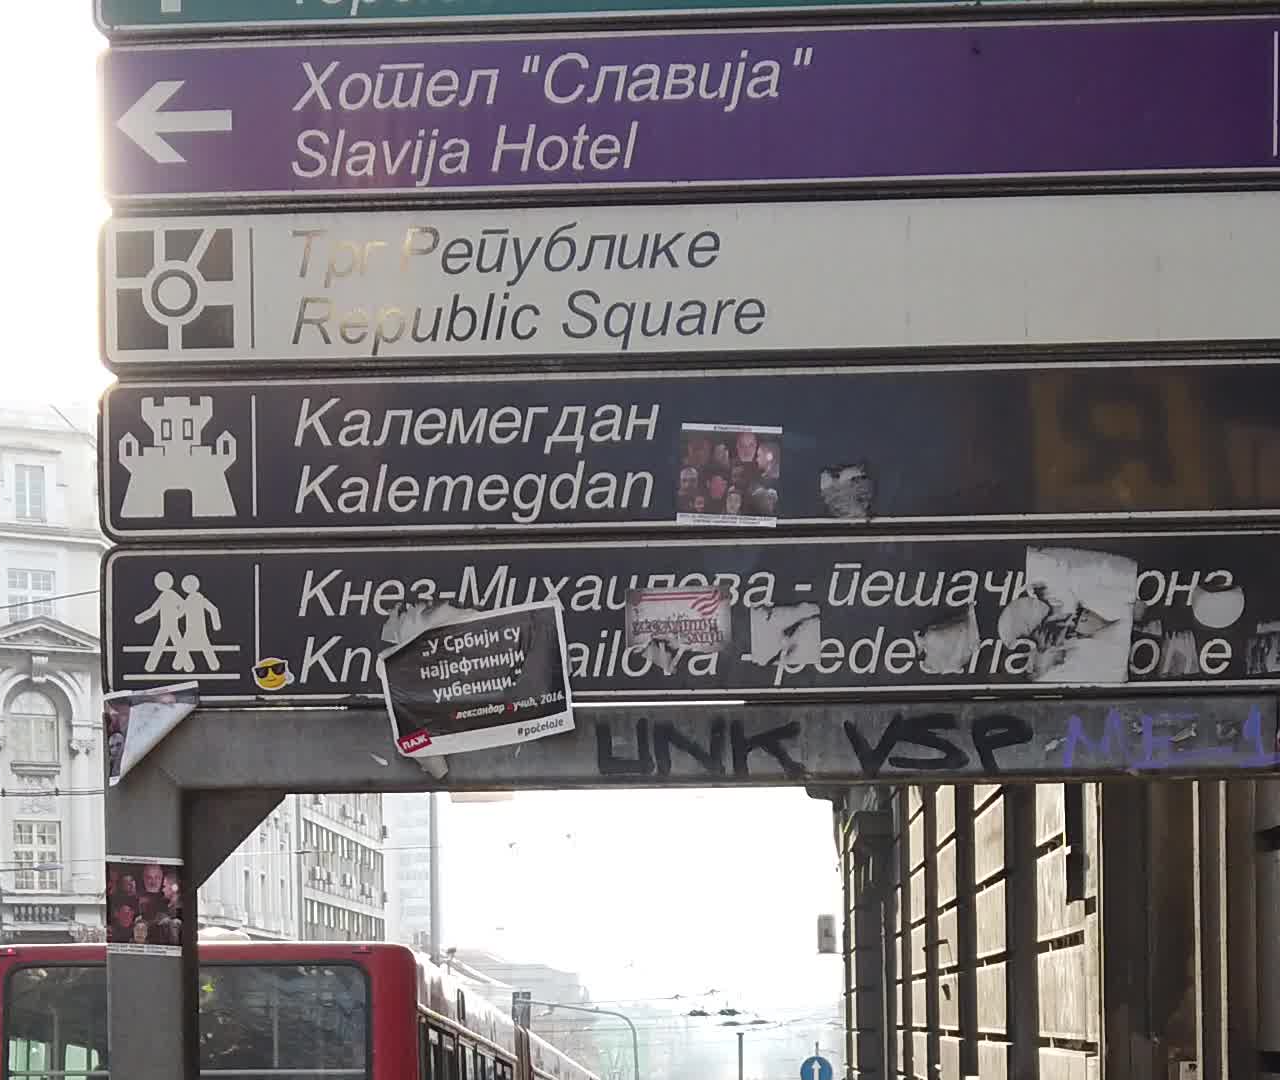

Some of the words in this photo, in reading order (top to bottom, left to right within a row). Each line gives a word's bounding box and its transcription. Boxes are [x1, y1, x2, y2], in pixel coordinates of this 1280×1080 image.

[292, 127, 471, 187] Slavija
[491, 121, 639, 173] Hotel
[291, 229, 389, 289] Трг
[292, 291, 540, 356] Republic
[562, 289, 767, 349] Square
[294, 398, 660, 454] Калемегдан
[294, 461, 655, 522] Kalemegdan
[420, 648, 525, 680] најјефтинији
[444, 629, 500, 653] Србији
[503, 626, 521, 642] су
